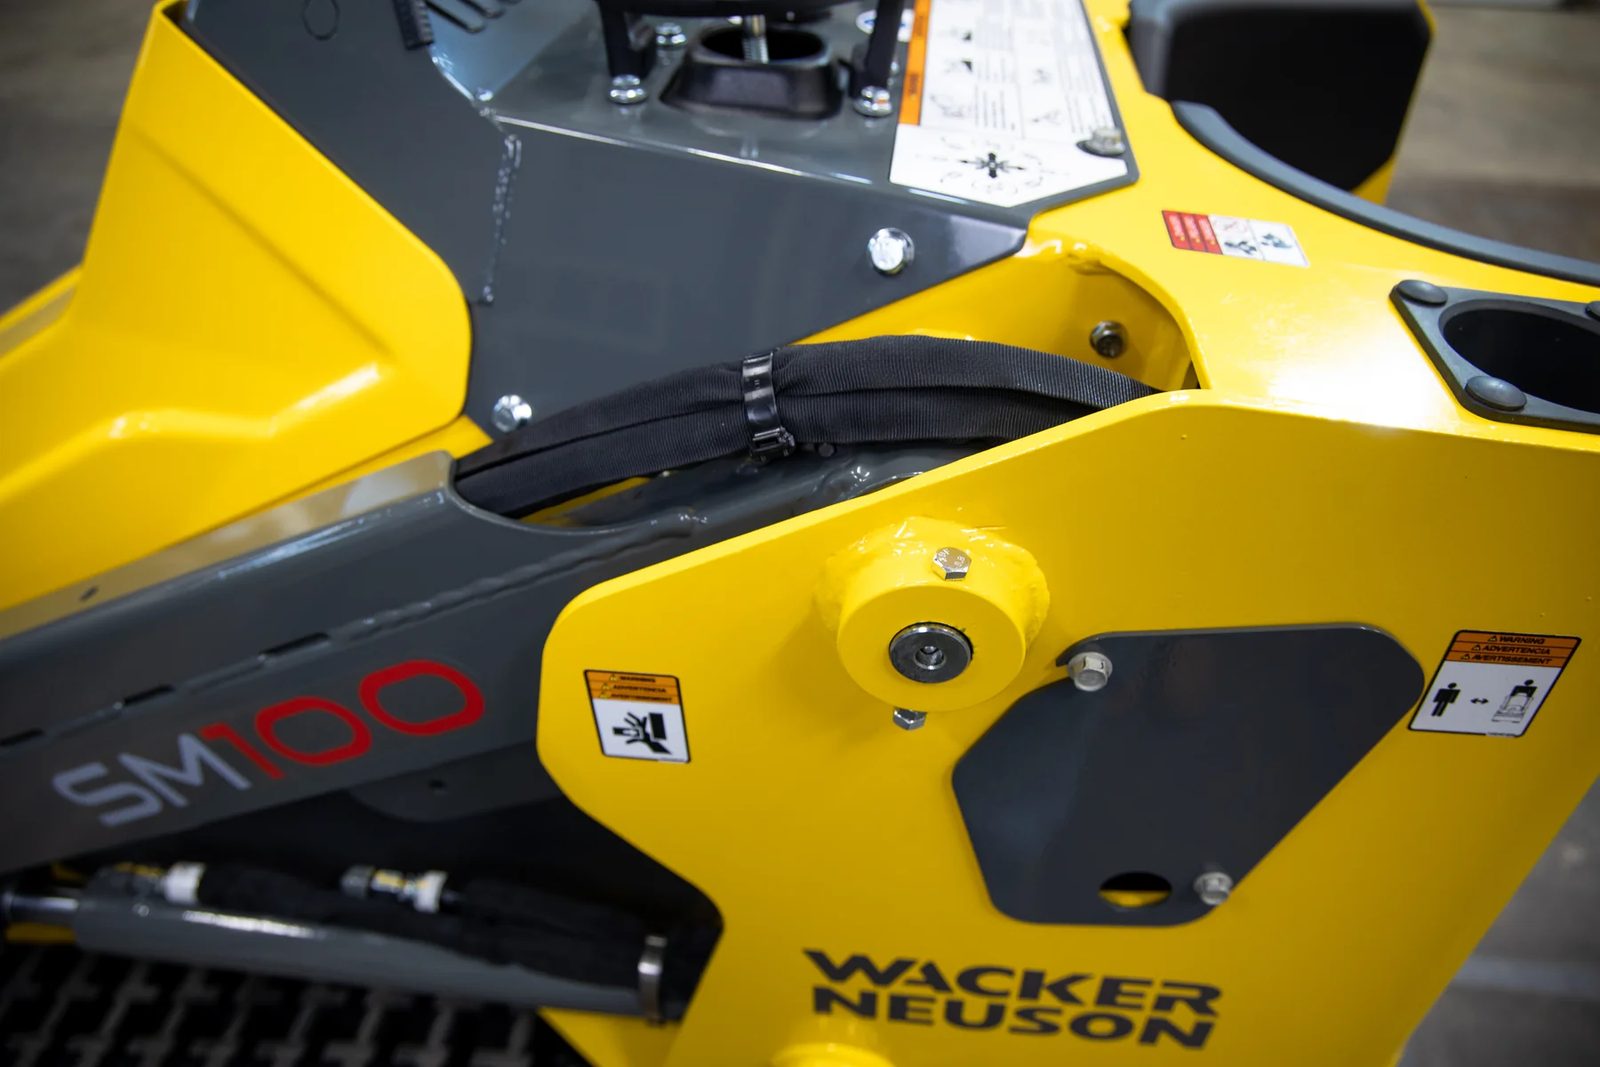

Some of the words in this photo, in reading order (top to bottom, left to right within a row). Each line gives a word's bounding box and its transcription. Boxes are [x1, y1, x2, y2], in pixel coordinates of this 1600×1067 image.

[1483, 644, 1552, 655] ADVERTENCIA
[1499, 636, 1546, 645] WARNING
[52, 658, 486, 828] SM100
[803, 947, 1223, 1017] WACKER
[812, 986, 1216, 1051] NEUSON
